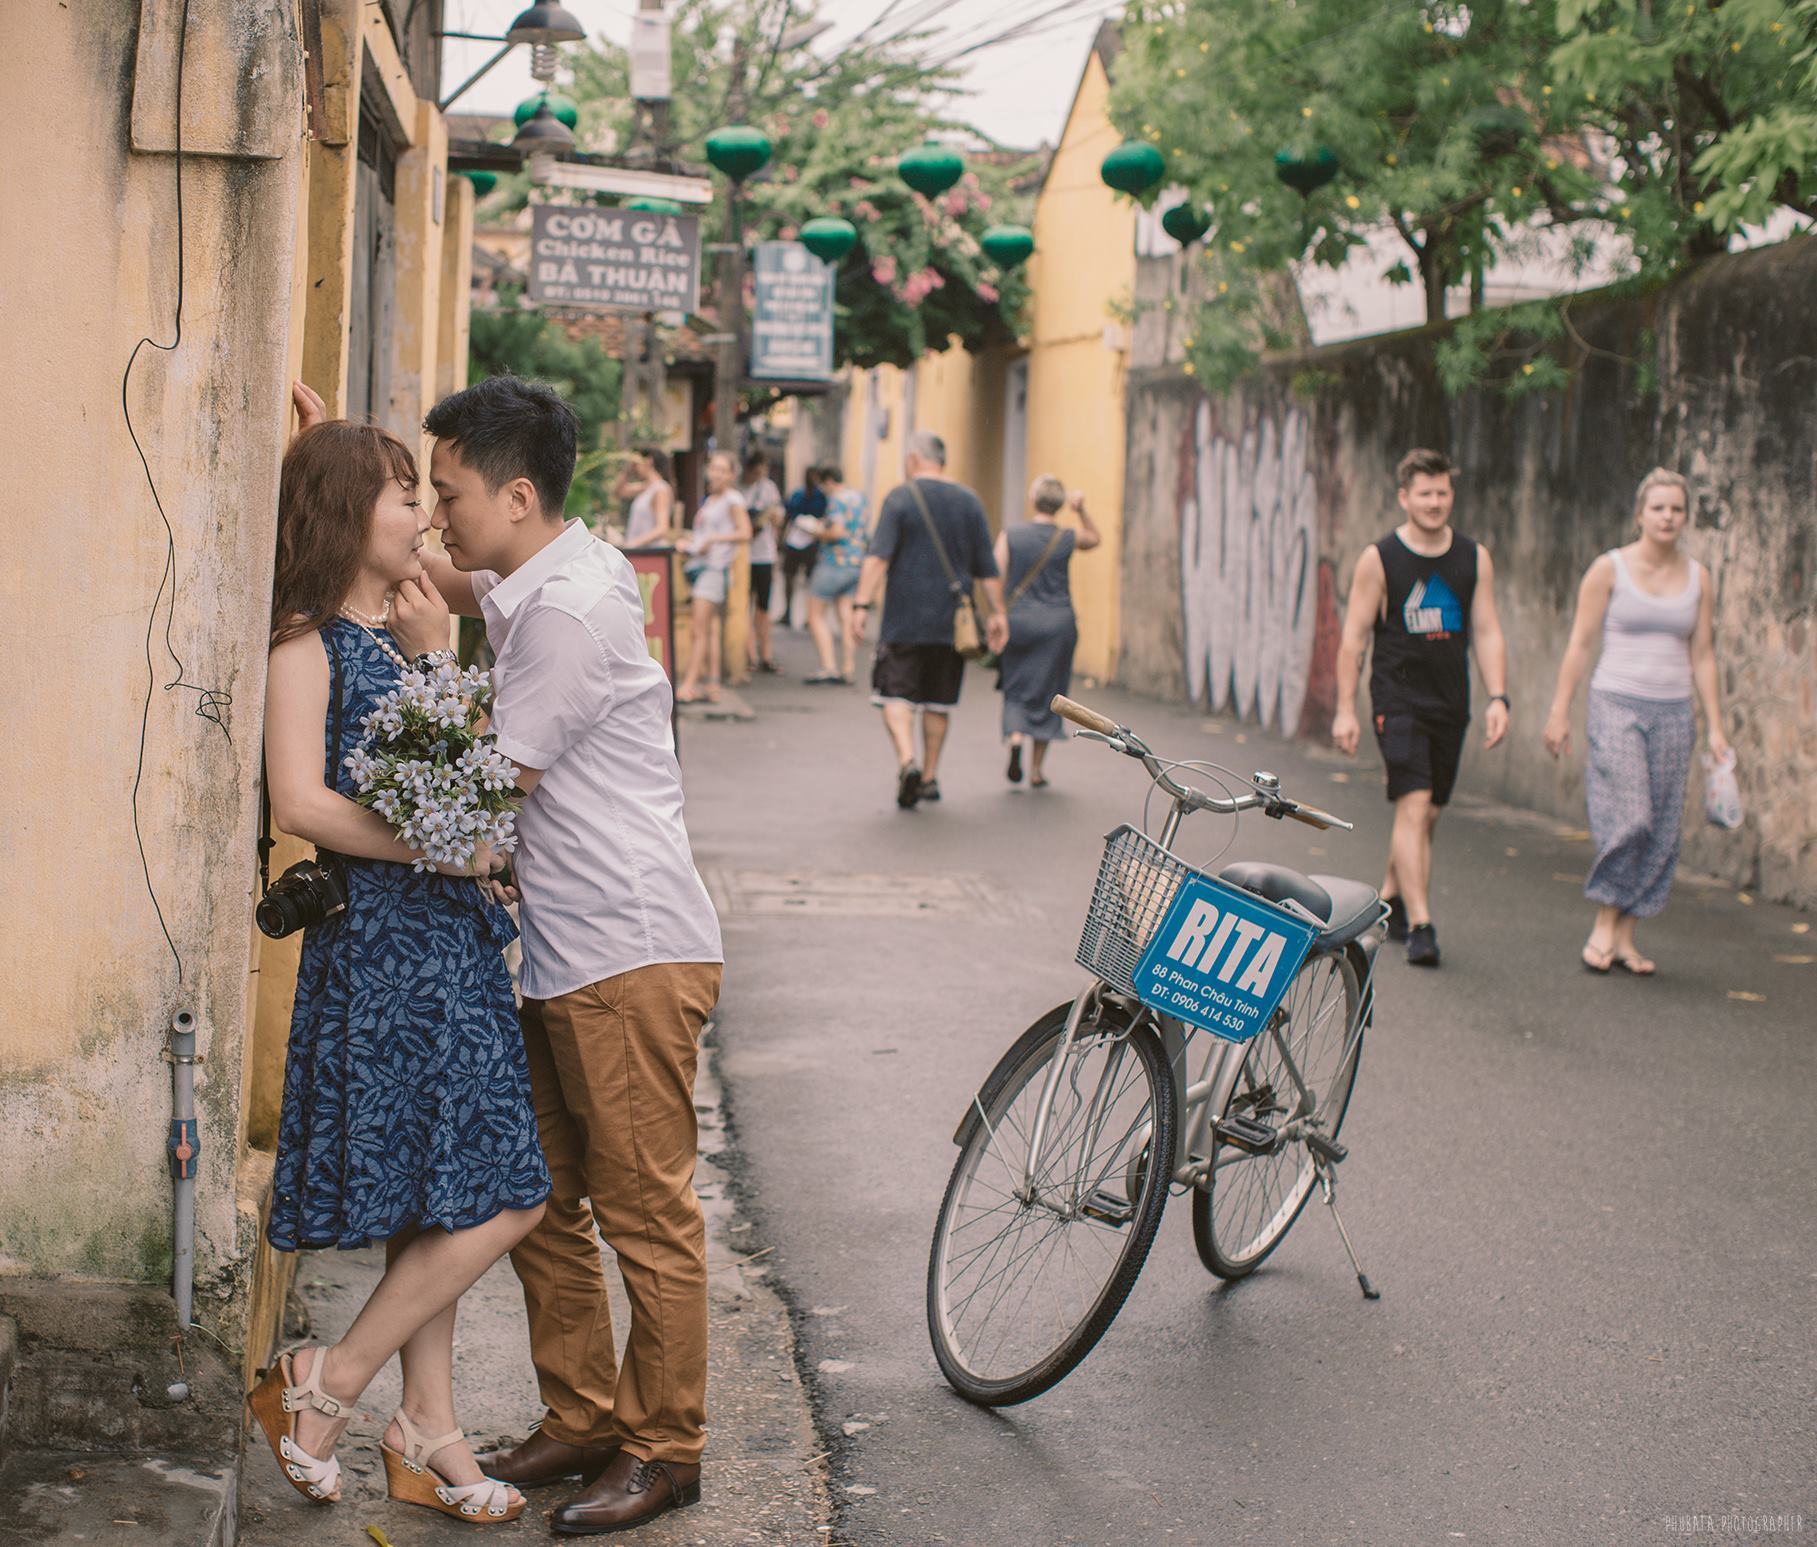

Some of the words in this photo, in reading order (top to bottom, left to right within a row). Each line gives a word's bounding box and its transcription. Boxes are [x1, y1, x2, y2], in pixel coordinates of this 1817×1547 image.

[545, 213, 624, 241] CƠM
[537, 238, 634, 262] Chicken
[640, 246, 690, 267] Rice
[1166, 898, 1287, 998] RITA
[1151, 983, 1170, 999] ĐT:
[1171, 992, 1200, 1012] 0906
[1200, 1005, 1222, 1022] 414
[1222, 1015, 1245, 1031] 530
[1152, 964, 1168, 978] 88
[1169, 971, 1199, 992] Phan
[1201, 985, 1233, 1007] Châu
[1233, 999, 1260, 1019] Trinh
